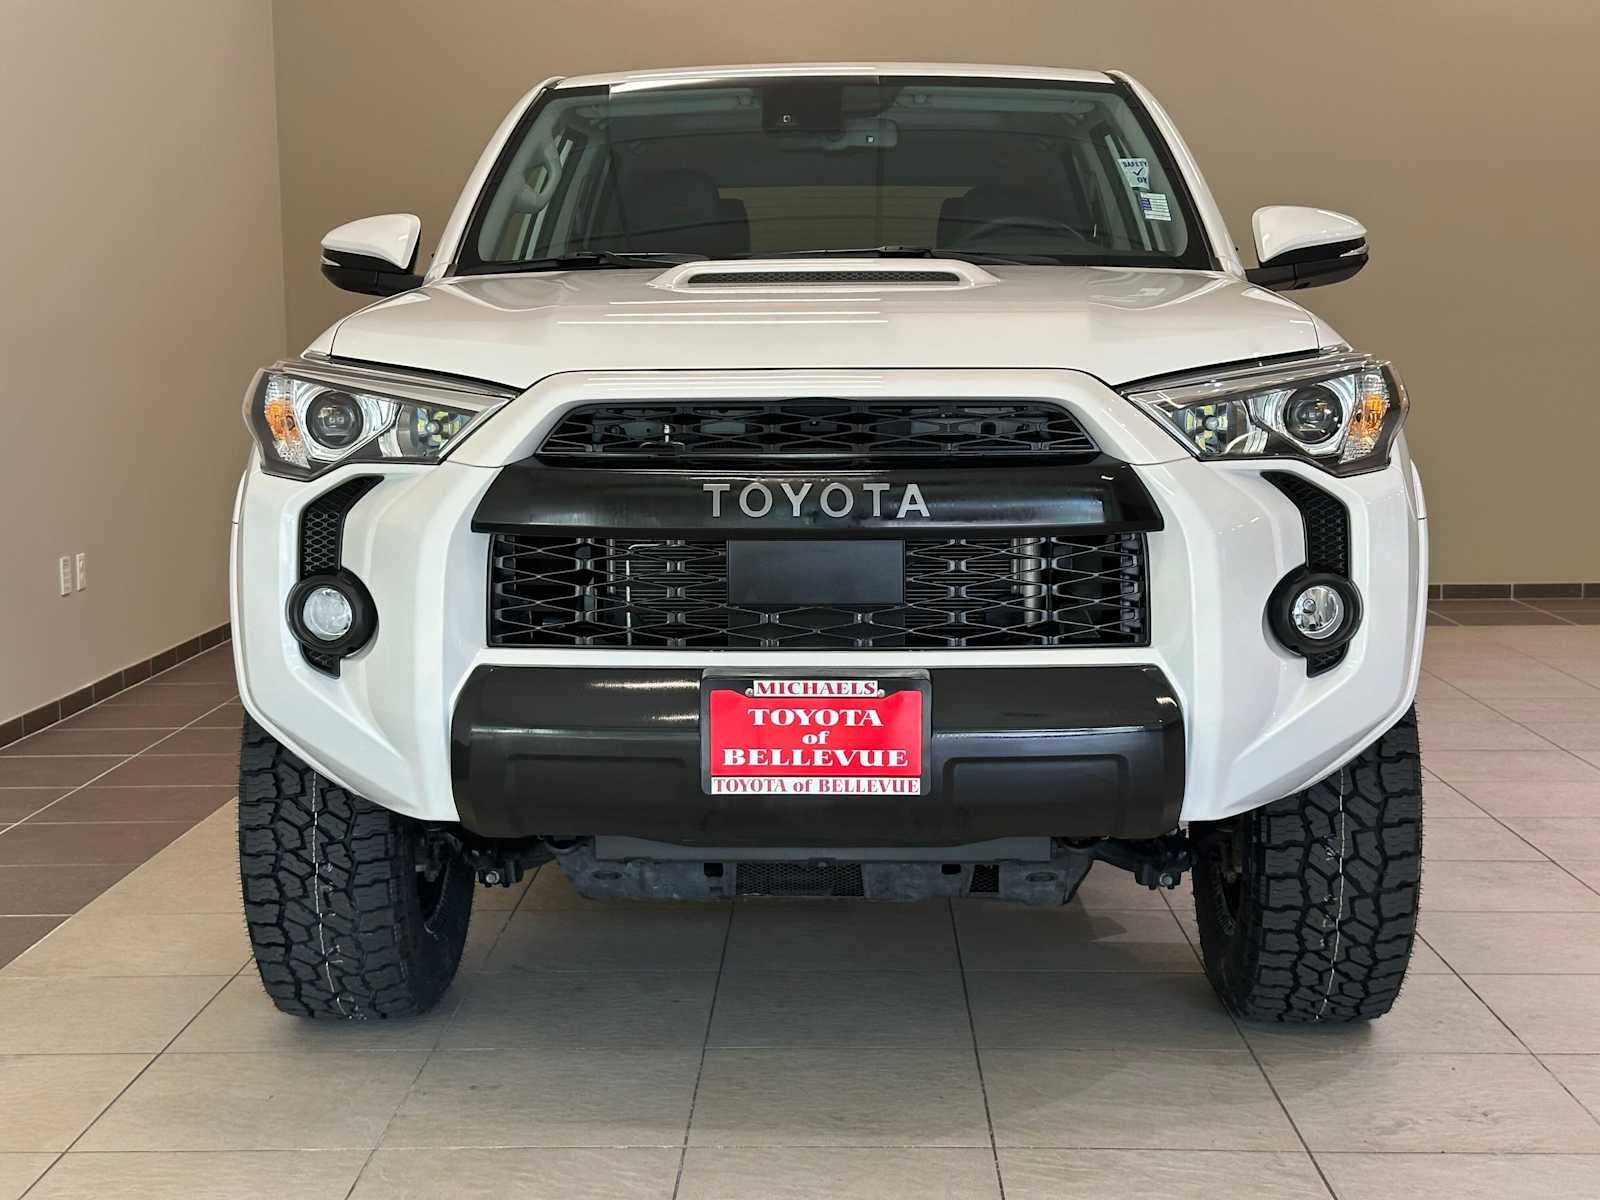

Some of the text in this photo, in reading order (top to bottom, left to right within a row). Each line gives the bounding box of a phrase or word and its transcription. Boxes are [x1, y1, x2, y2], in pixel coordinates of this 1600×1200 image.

[702, 482, 930, 518] TOYOTA
[756, 682, 876, 695] MICHAELS
[747, 708, 883, 727] TOYOTA
[801, 730, 830, 745] of
[722, 748, 909, 767] BELLEVUE
[713, 778, 919, 793] TOYOTA of BELLEVUE
